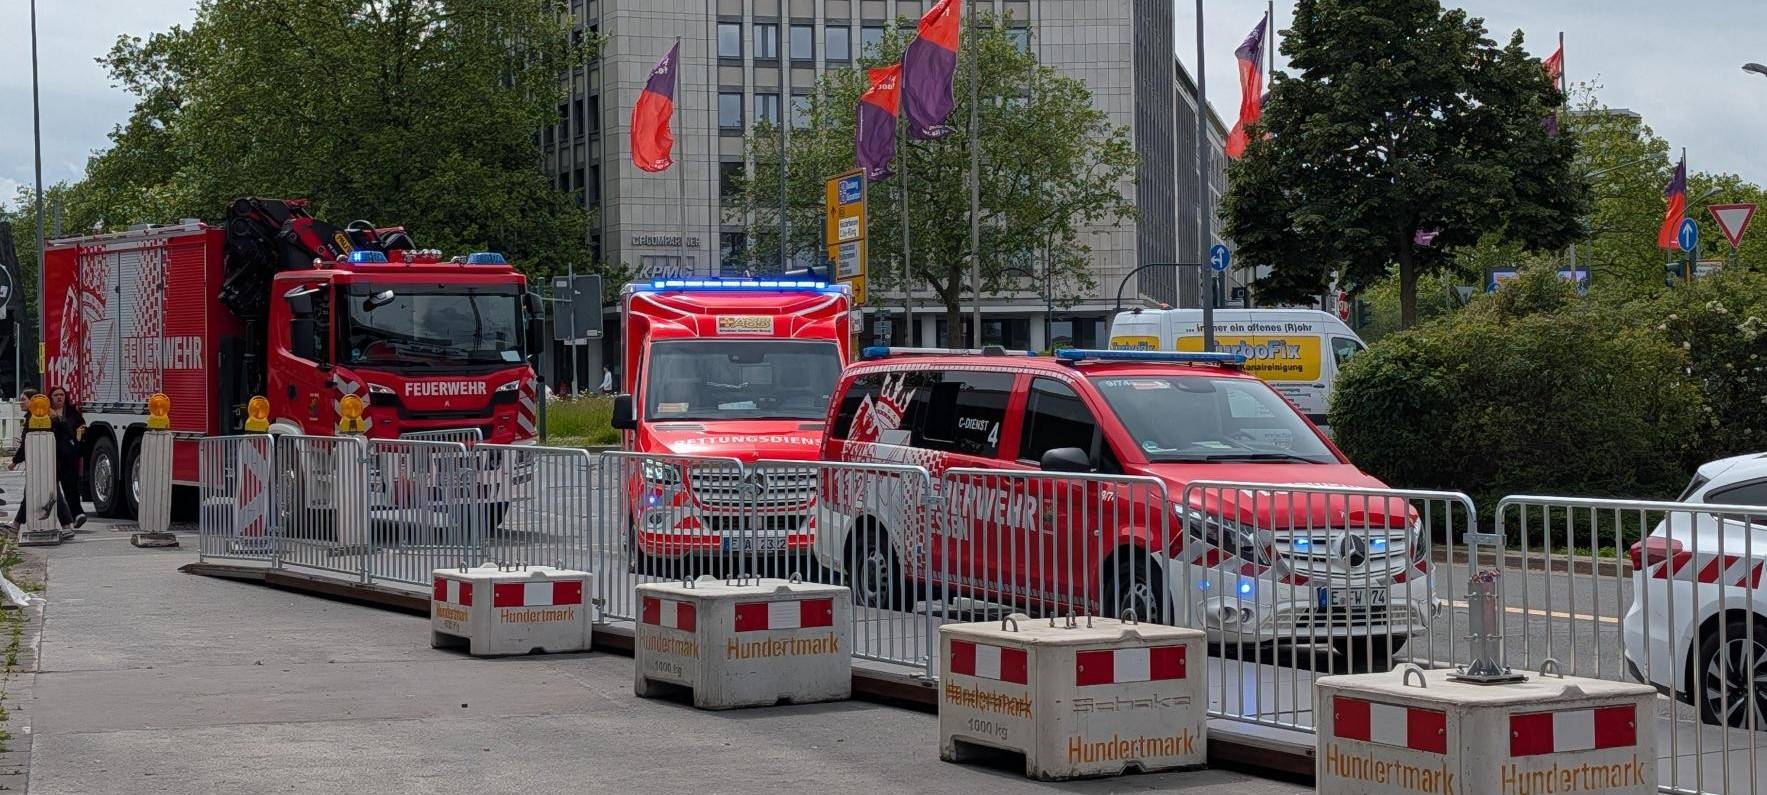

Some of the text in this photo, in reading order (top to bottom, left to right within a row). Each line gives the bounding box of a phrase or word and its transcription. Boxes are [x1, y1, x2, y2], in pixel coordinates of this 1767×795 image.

[640, 265, 694, 279] KPMG
[1230, 323, 1244, 332] ein
[1247, 323, 1282, 332] offenes
[1285, 323, 1312, 333] (R)ohr
[121, 336, 203, 370] FEUERWEHR
[1214, 340, 1301, 360] urboFix
[48, 356, 71, 393] 112
[130, 371, 157, 392] ESSEN
[404, 382, 487, 397] FEUERWEHR
[674, 434, 822, 448] RETTUNGSDIENS
[958, 416, 999, 448] C-DIENST 4
[1101, 490, 1114, 502] 9/7
[929, 504, 969, 541] ESEN
[1371, 590, 1385, 604] 74
[501, 607, 574, 624] Hundertmark
[727, 632, 839, 660] Hundertmark
[968, 718, 1008, 740] 1000 kg
[1068, 728, 1194, 764] Hundertmark
[1326, 743, 1454, 795] Hundertmark
[1501, 753, 1645, 795] Hundertmark
